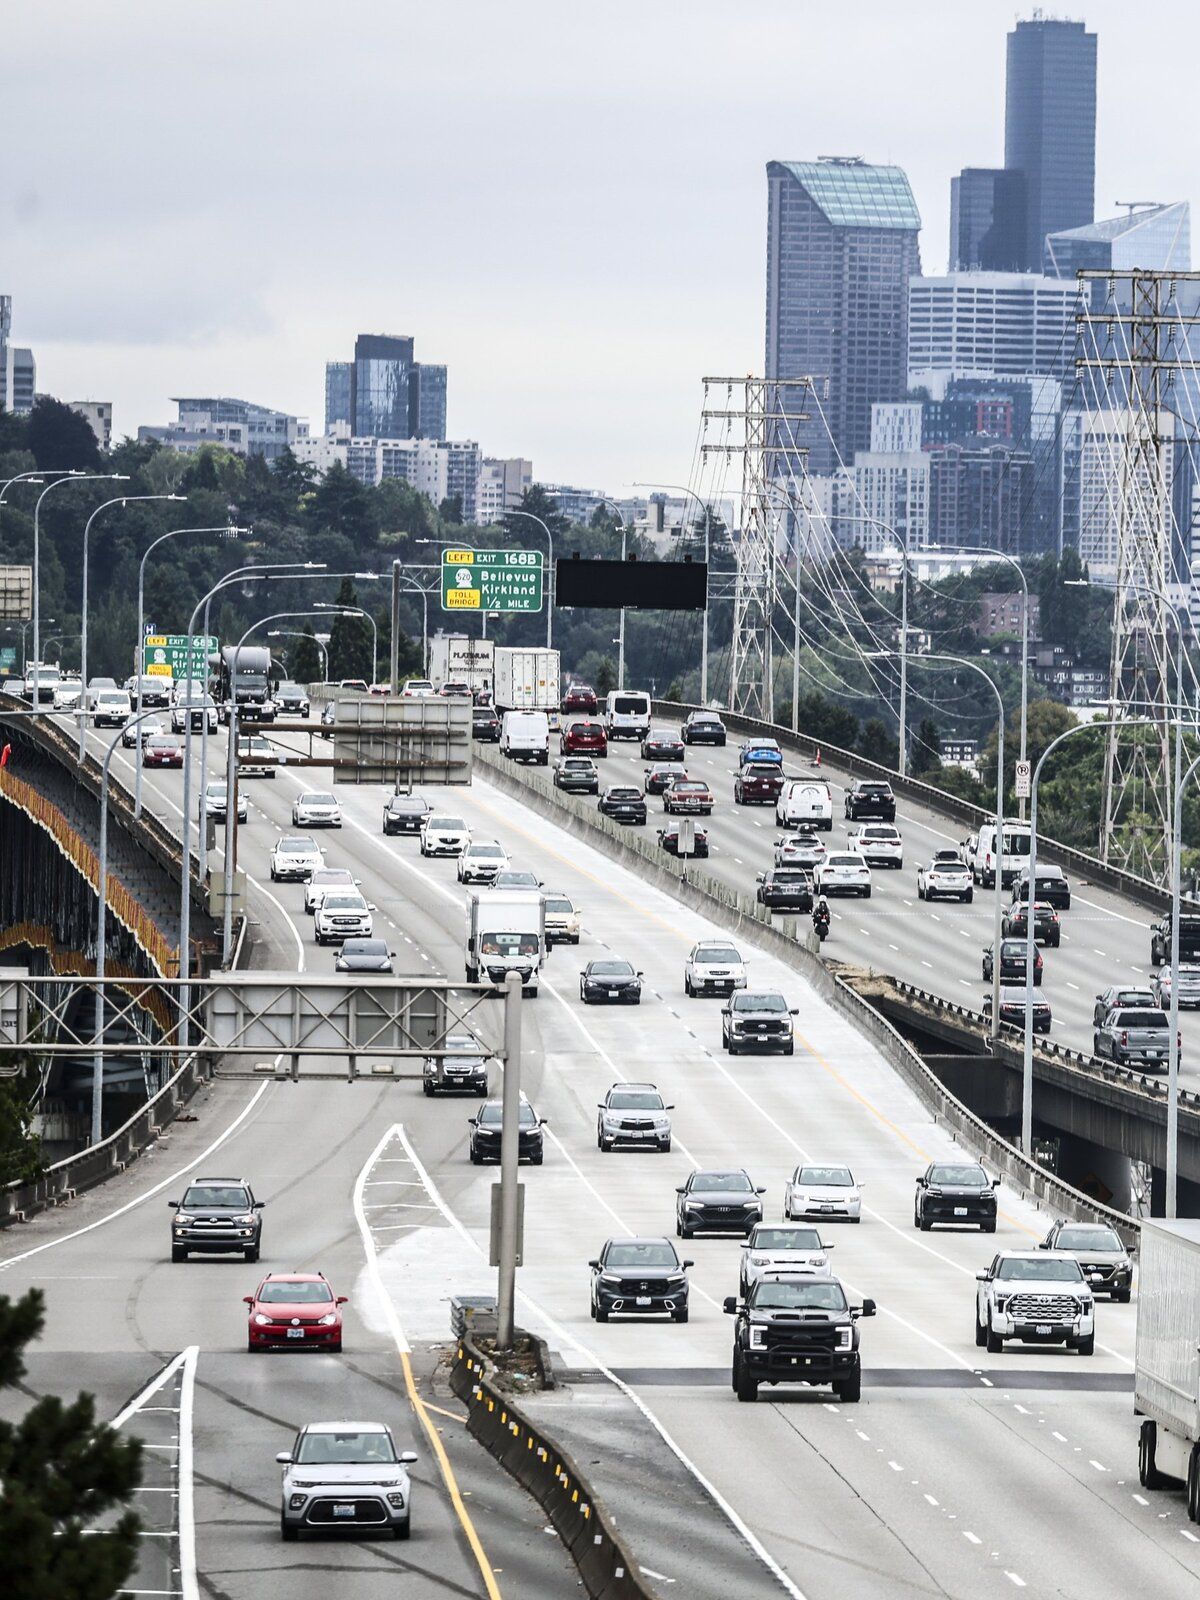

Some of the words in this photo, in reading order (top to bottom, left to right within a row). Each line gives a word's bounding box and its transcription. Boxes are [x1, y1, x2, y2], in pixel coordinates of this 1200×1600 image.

[448, 553, 471, 562] LEFT
[477, 554, 496, 563] EXIT
[505, 553, 536, 565] 168B
[457, 573, 471, 581] 520
[481, 570, 536, 582] Bellevue
[482, 584, 536, 595] Kirkland
[454, 591, 474, 599] TOLL
[487, 597, 500, 609] 1/2
[508, 600, 530, 609] MILE
[146, 625, 154, 635] H
[191, 638, 213, 647] 68B
